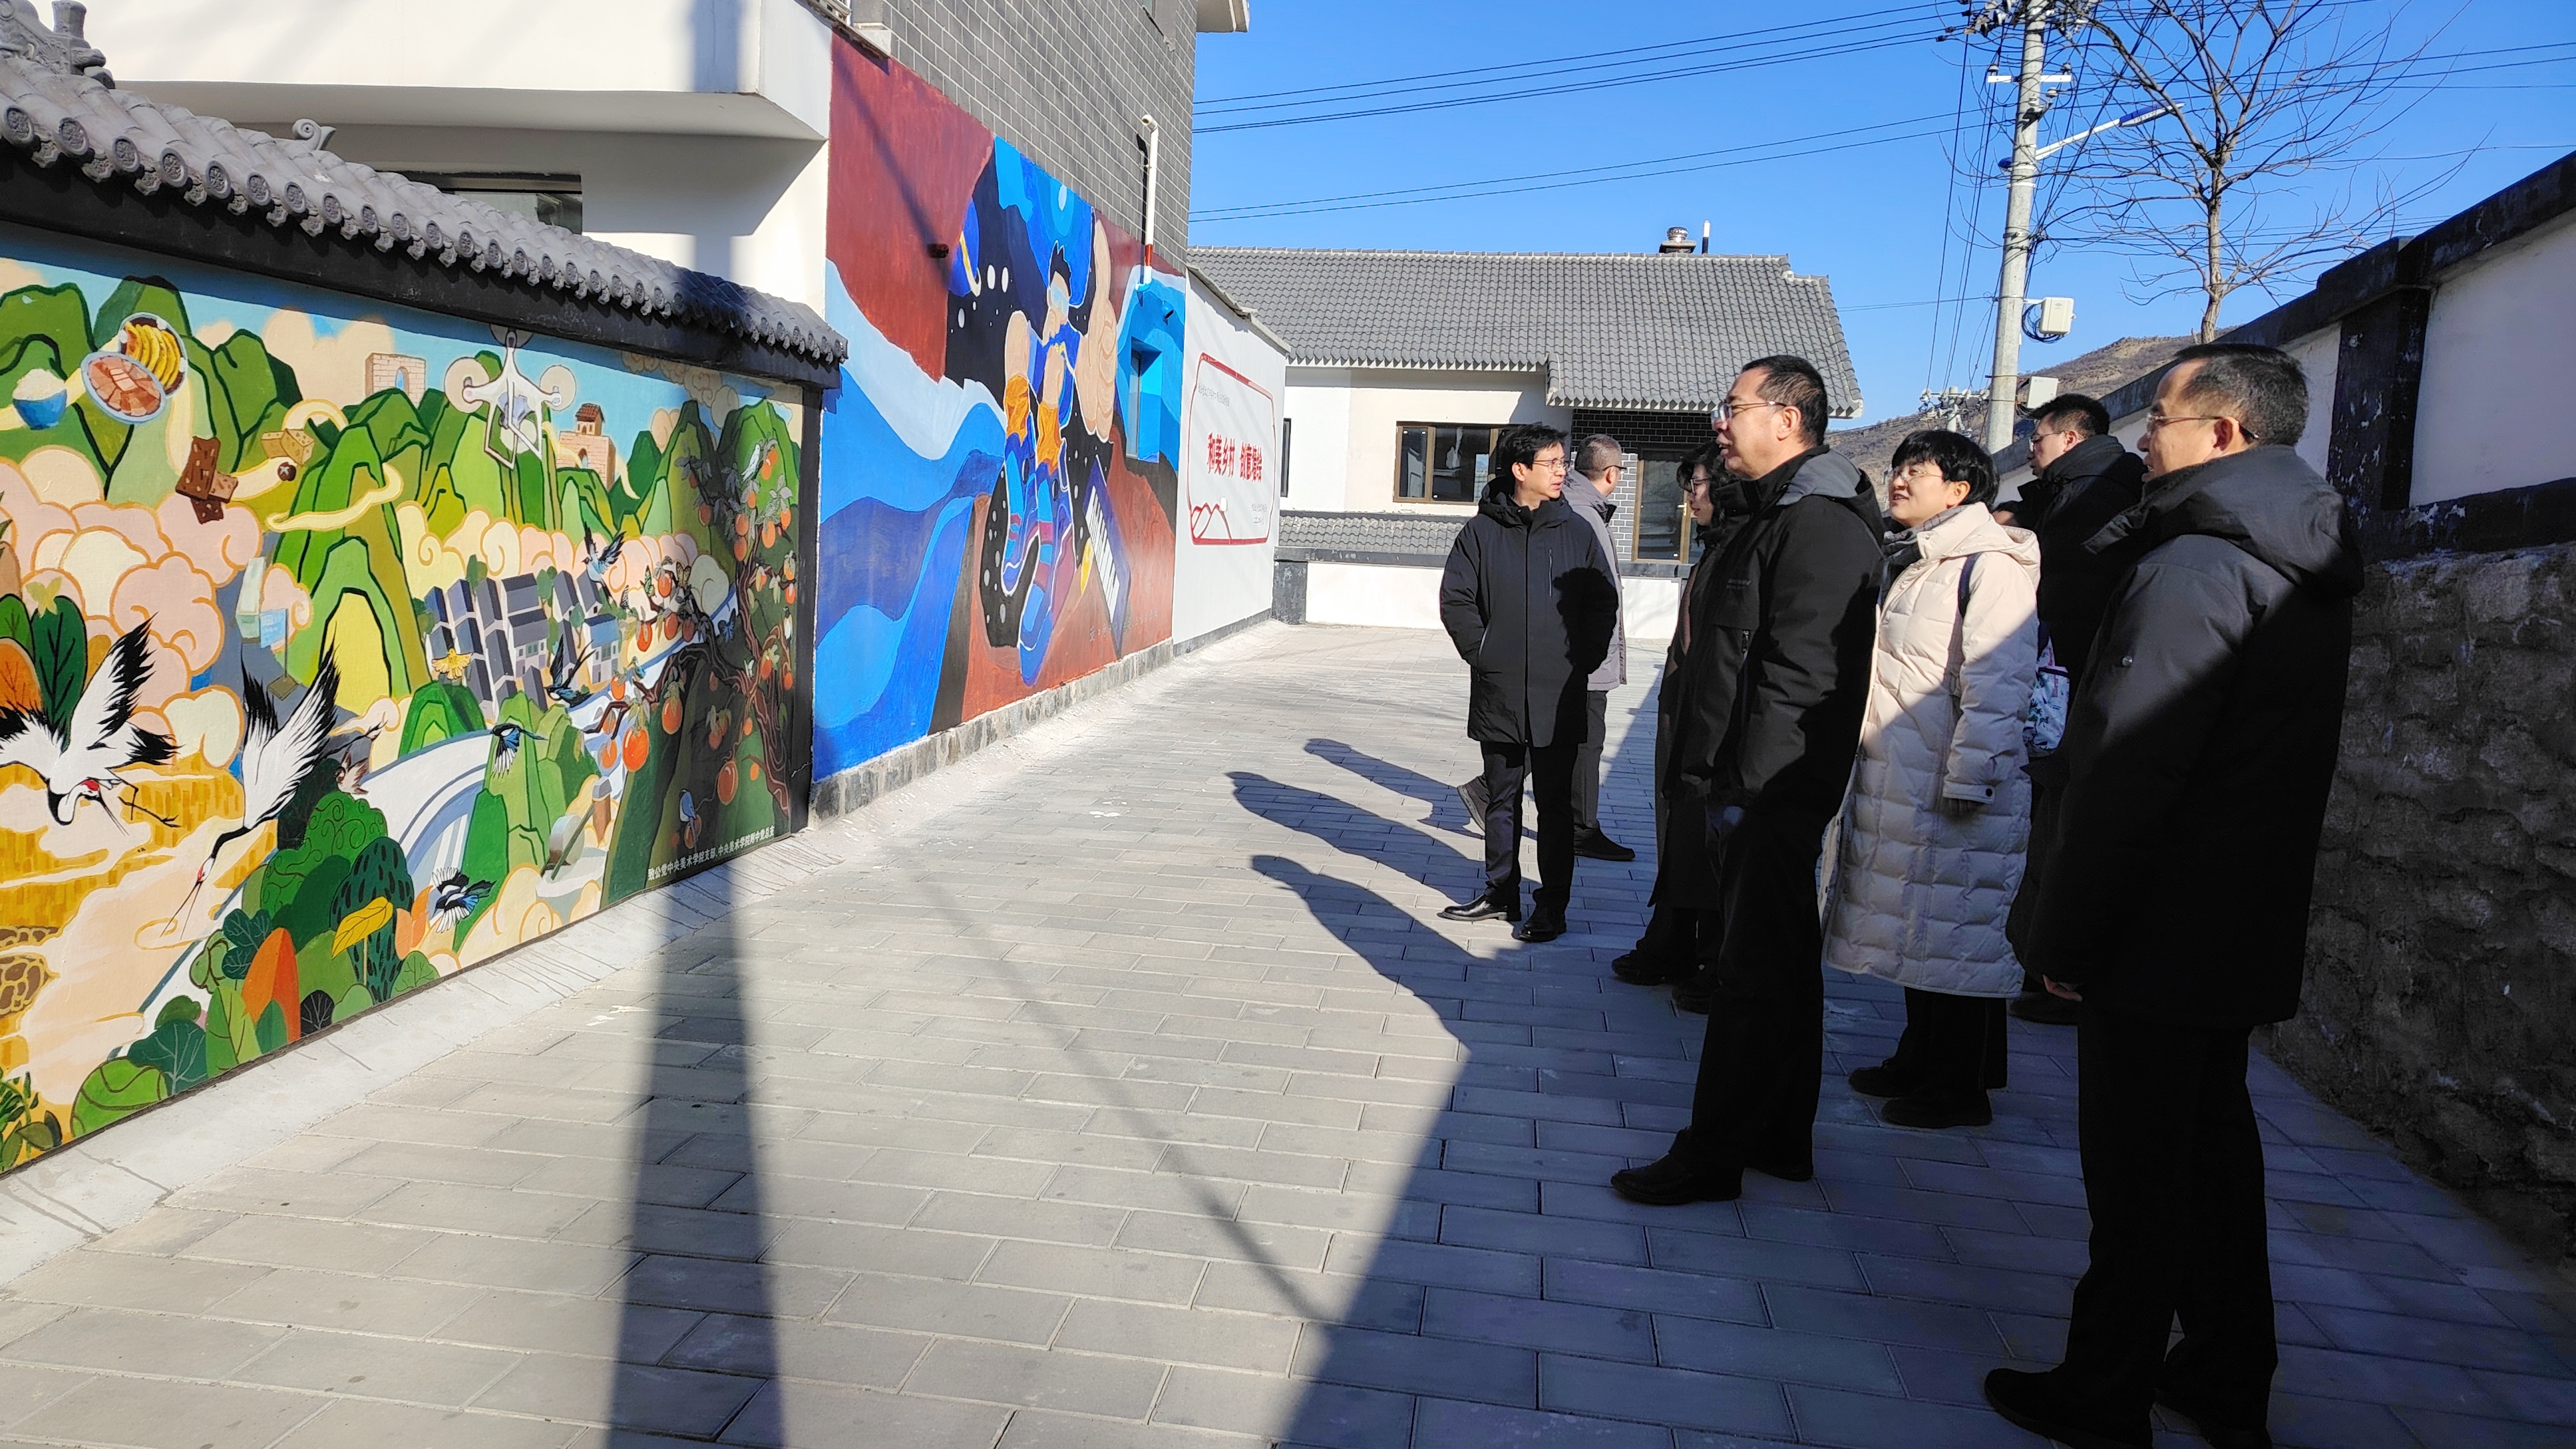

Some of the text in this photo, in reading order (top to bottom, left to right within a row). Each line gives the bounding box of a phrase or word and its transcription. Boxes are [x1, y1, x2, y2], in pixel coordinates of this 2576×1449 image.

[1206, 432, 1262, 483] 和美乡村 创意墙绘
